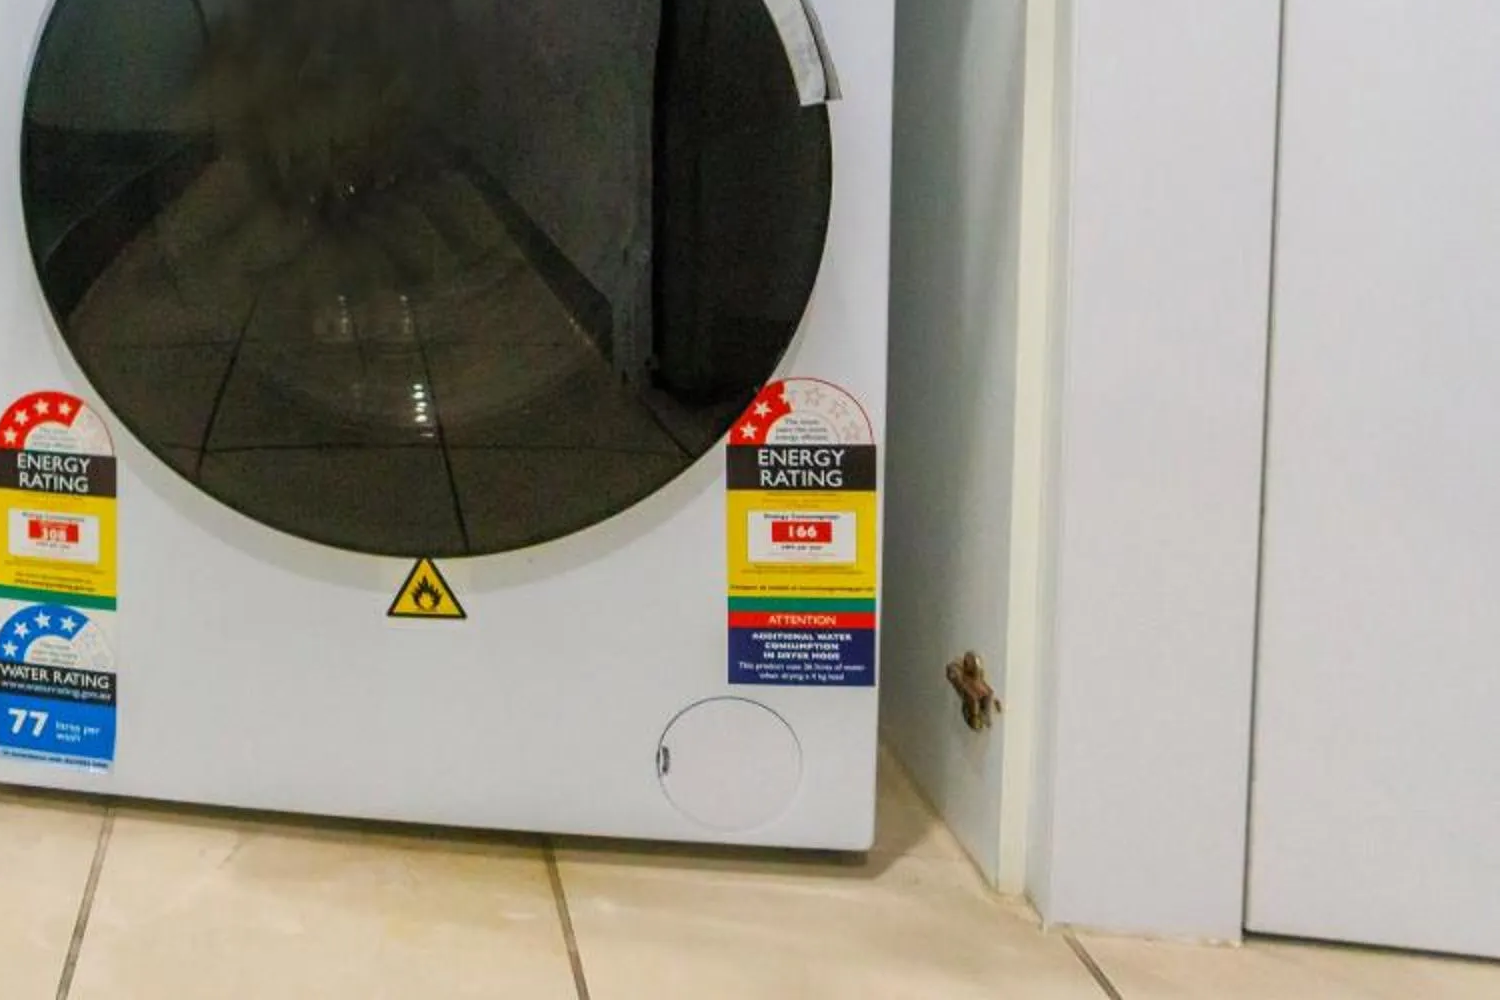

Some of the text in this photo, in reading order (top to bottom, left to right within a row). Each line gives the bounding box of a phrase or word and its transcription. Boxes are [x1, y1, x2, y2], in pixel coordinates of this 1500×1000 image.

[17, 455, 91, 474] ENERGY
[757, 449, 845, 467] ENERGY
[19, 474, 89, 492] RATING
[760, 469, 843, 488] RATING
[788, 525, 817, 538] 166
[768, 615, 837, 625] ATTENTION
[752, 632, 852, 641] ADDITIONAL WATER
[764, 642, 839, 650] CONSUMPTION
[0, 663, 110, 689] WATER RATING
[8, 708, 49, 738] 77
[83, 725, 100, 736] per
